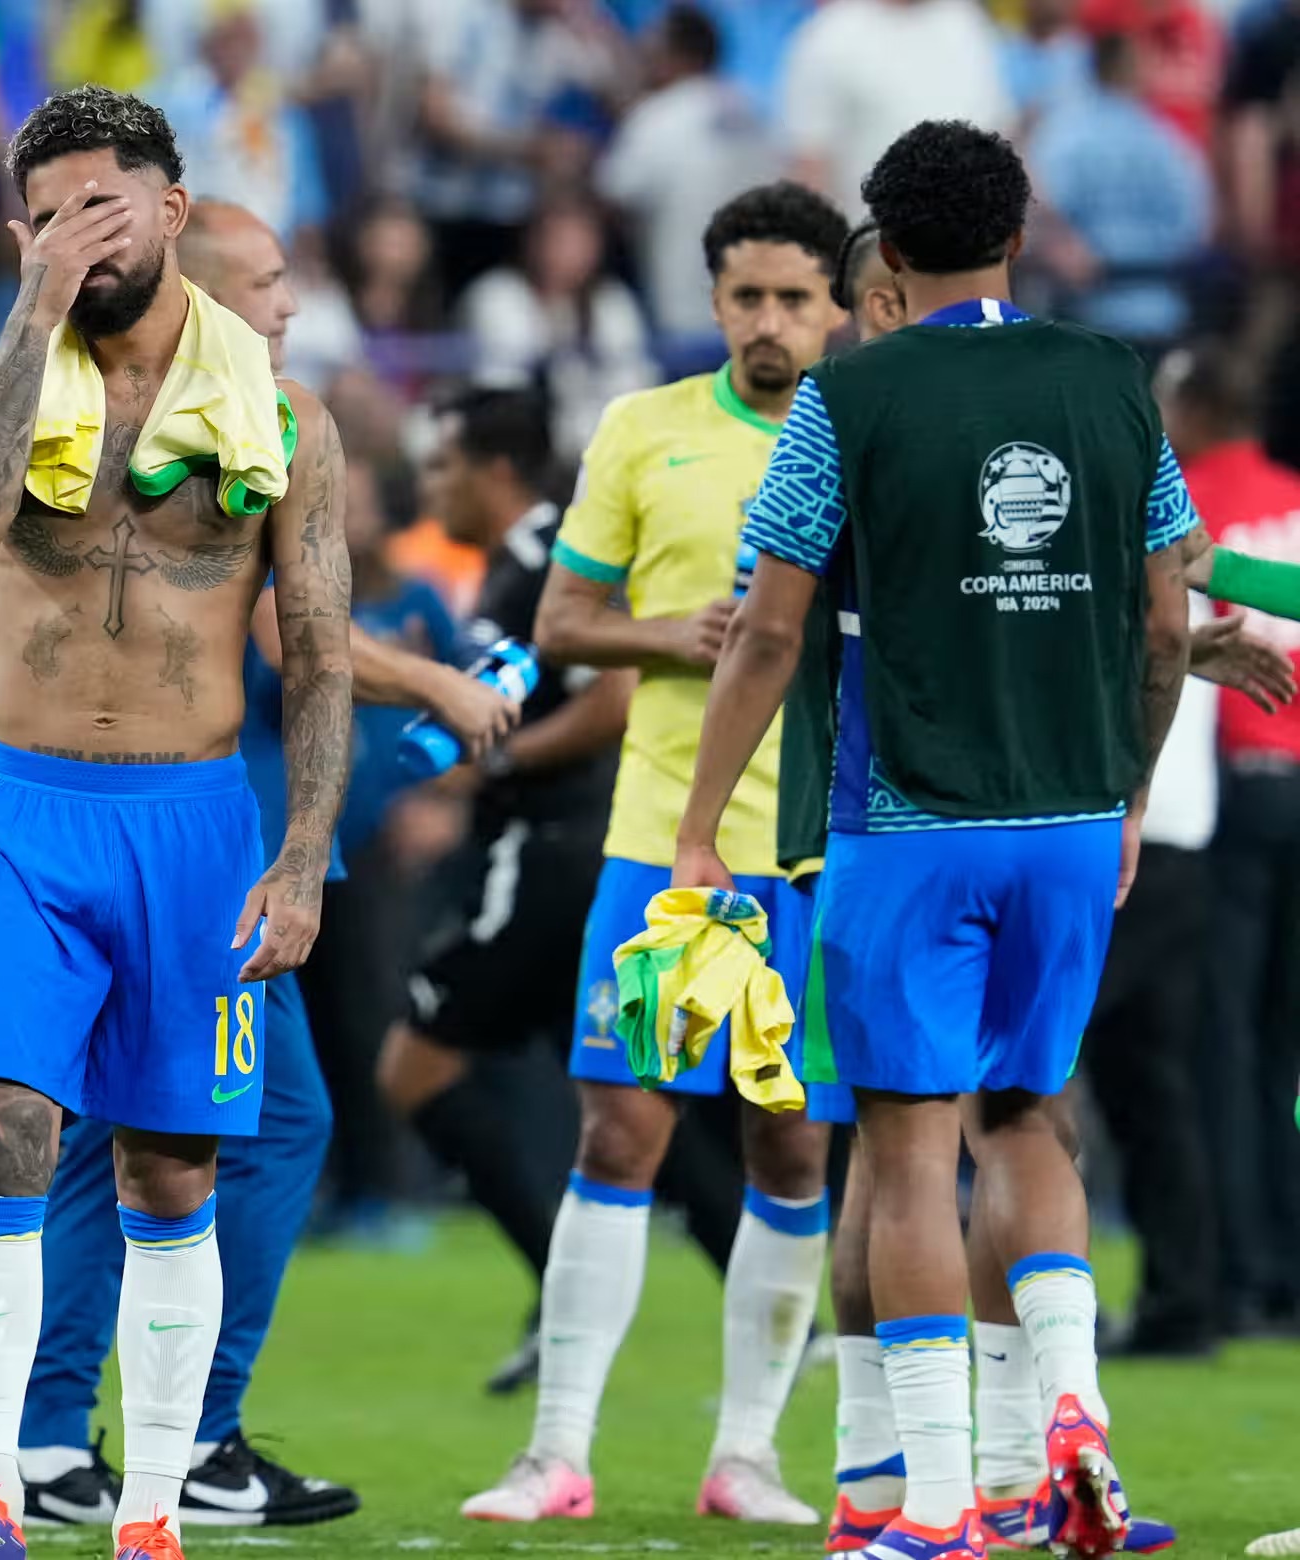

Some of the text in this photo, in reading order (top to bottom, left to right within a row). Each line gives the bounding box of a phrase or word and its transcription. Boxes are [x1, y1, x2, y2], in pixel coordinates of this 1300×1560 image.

[996, 596, 1060, 611] USA 2024
[214, 991, 256, 1076] 18
